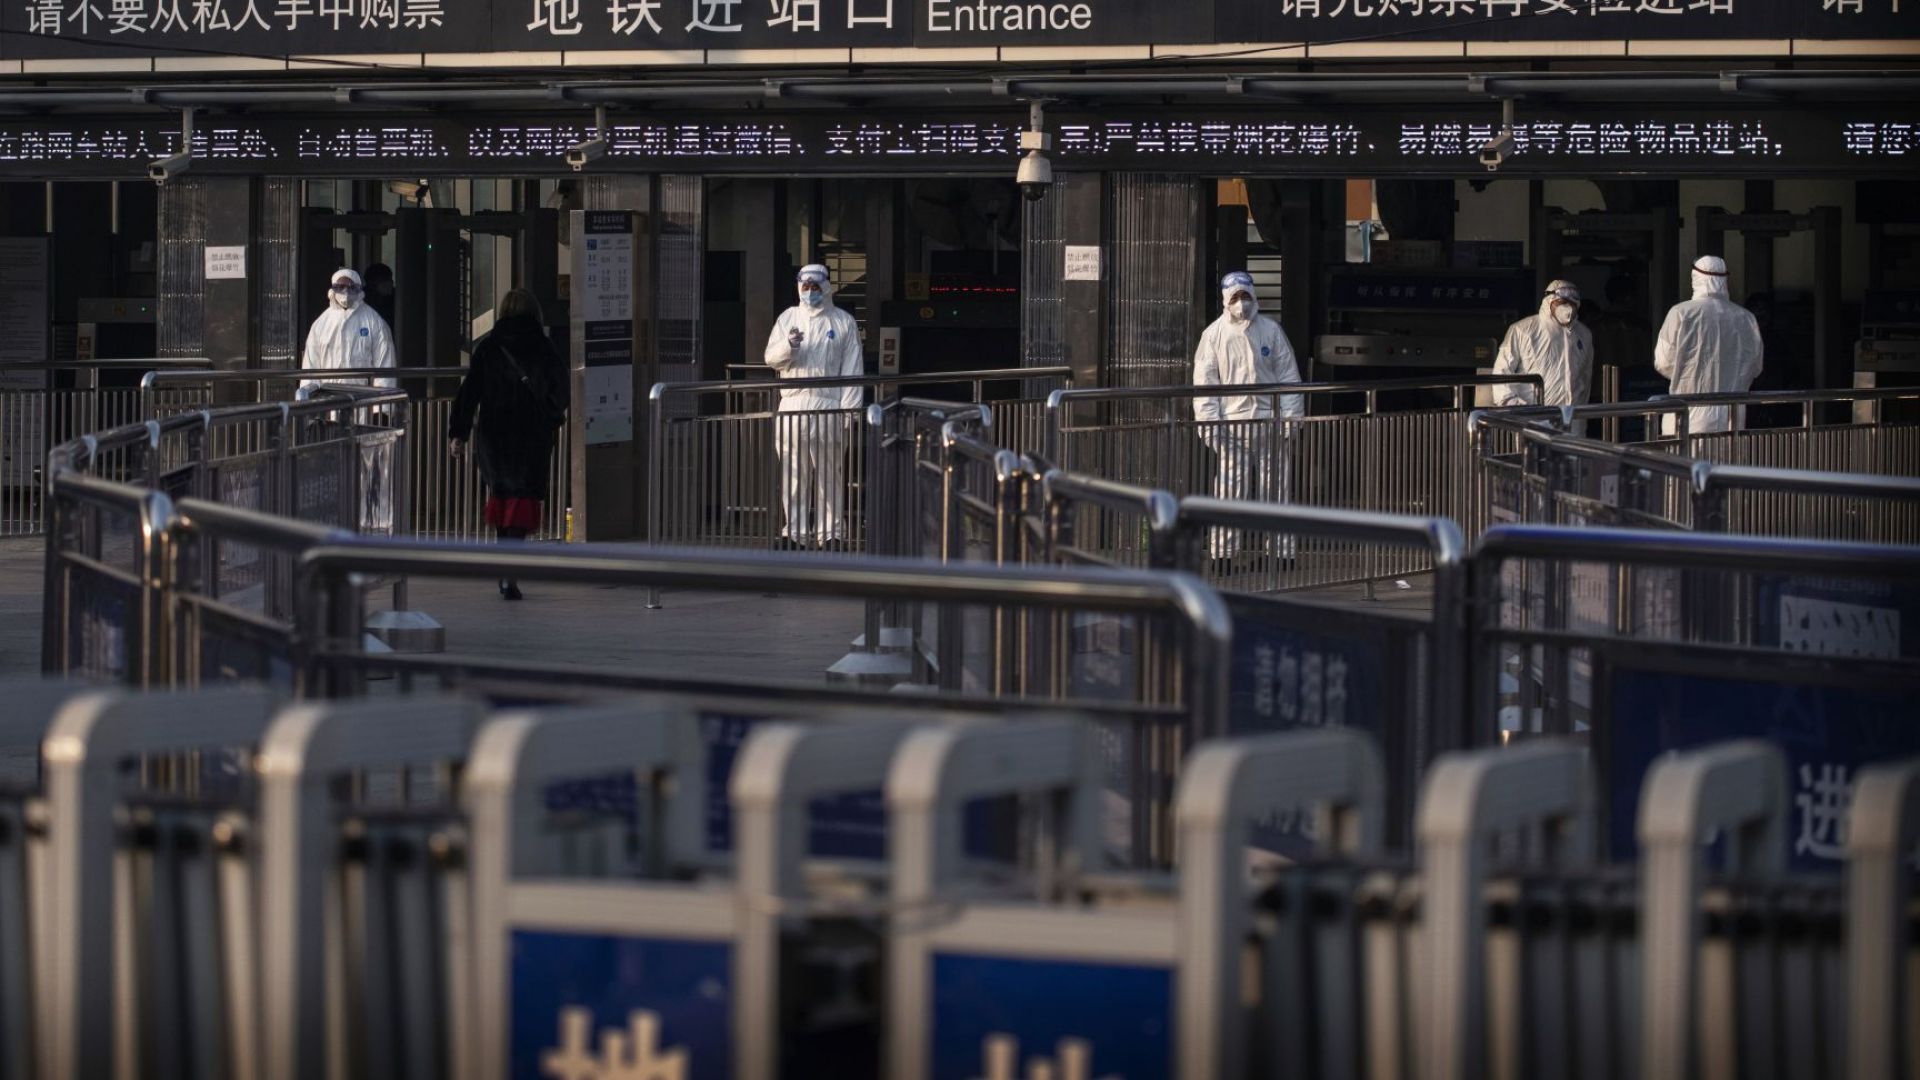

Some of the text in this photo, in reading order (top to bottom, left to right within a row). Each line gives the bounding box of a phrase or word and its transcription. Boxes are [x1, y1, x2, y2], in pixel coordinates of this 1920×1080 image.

[26, 0, 445, 35] 请不要从私人手中购票
[928, 0, 1092, 32] Entrance
